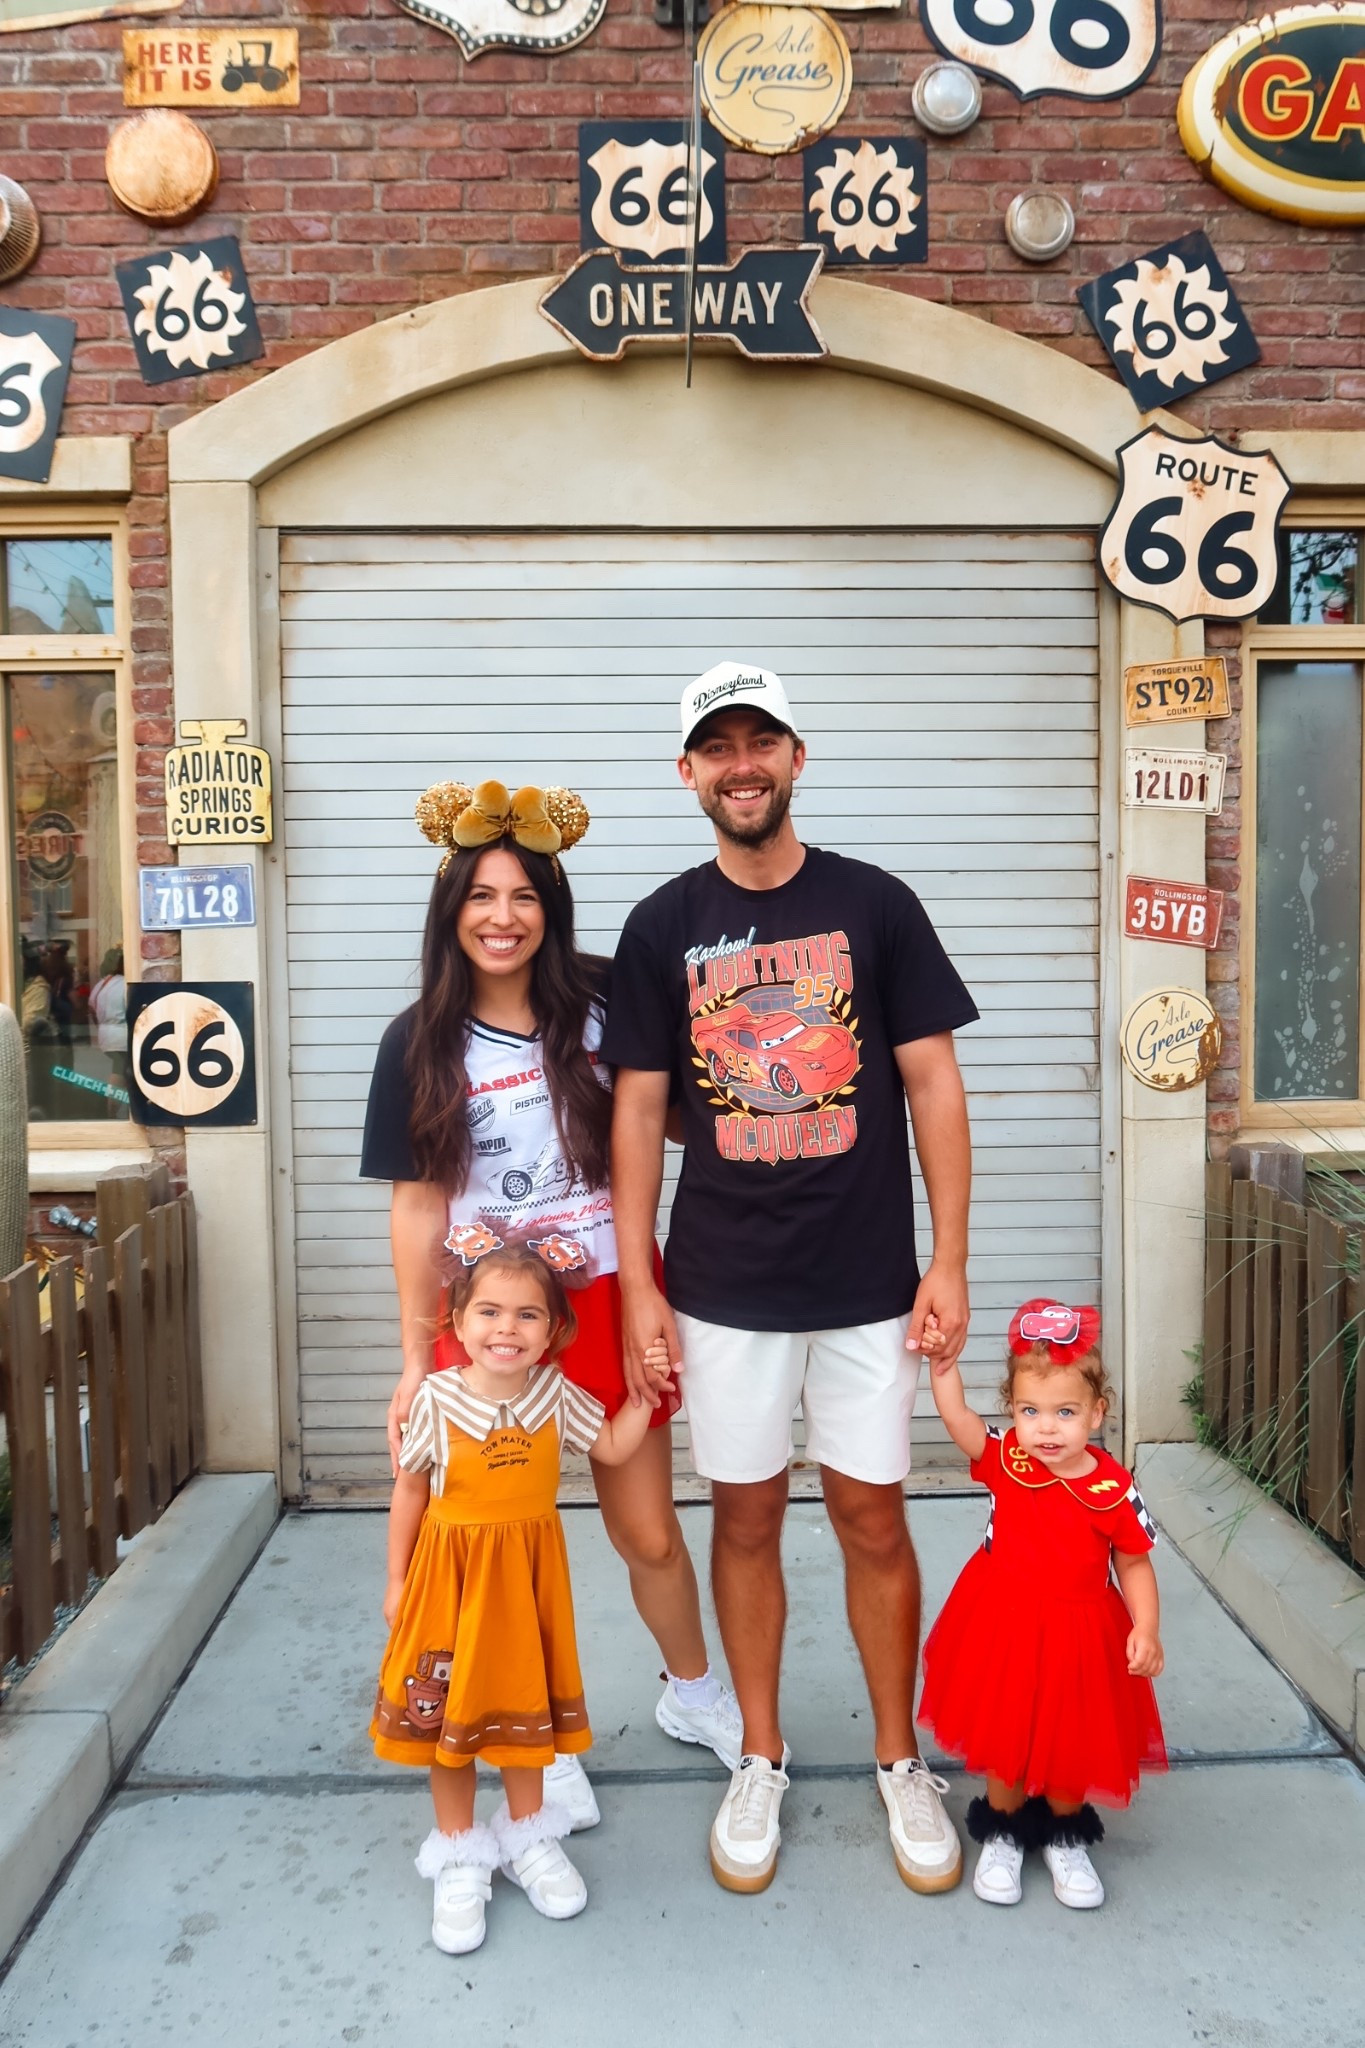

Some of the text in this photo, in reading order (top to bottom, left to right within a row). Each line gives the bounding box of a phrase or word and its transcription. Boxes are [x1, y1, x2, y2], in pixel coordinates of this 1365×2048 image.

[138, 42, 212, 66] HERE
[762, 25, 814, 54] Axle
[139, 69, 212, 92] IT IS
[715, 33, 832, 99] Grease
[609, 166, 698, 226] 66
[830, 170, 901, 228] 66
[155, 276, 229, 341] 66
[588, 281, 783, 327] ONE WAY
[1132, 279, 1216, 360] 66
[1155, 452, 1259, 496] ROUTE
[1124, 495, 1259, 601] 66
[1152, 663, 1203, 676] TORQUEVILLE
[693, 673, 766, 713] Disneyland
[1166, 705, 1198, 716] COUNTY
[168, 750, 264, 789] RADIATOR
[180, 786, 252, 814] SPRINGS
[171, 815, 266, 836] CURIOS
[156, 884, 239, 920] 7BL28
[1154, 888, 1208, 903] ROLLINGSTOP
[1131, 896, 1207, 936] 35YB
[684, 926, 757, 970] Kachow!
[686, 930, 854, 1017] LIGHTNING
[793, 971, 836, 1010] 95
[1161, 1001, 1191, 1032] Axle
[139, 1021, 234, 1088] 66
[1137, 1017, 1206, 1072] Grease
[467, 1067, 543, 1098] LASSIC
[723, 1049, 753, 1083] 95
[515, 1093, 550, 1110] PISTON
[715, 1105, 858, 1166] MCQUEEN
[480, 1440, 498, 1456] TOW
[500, 1435, 532, 1449] MATER
[1009, 1446, 1034, 1473] 95
